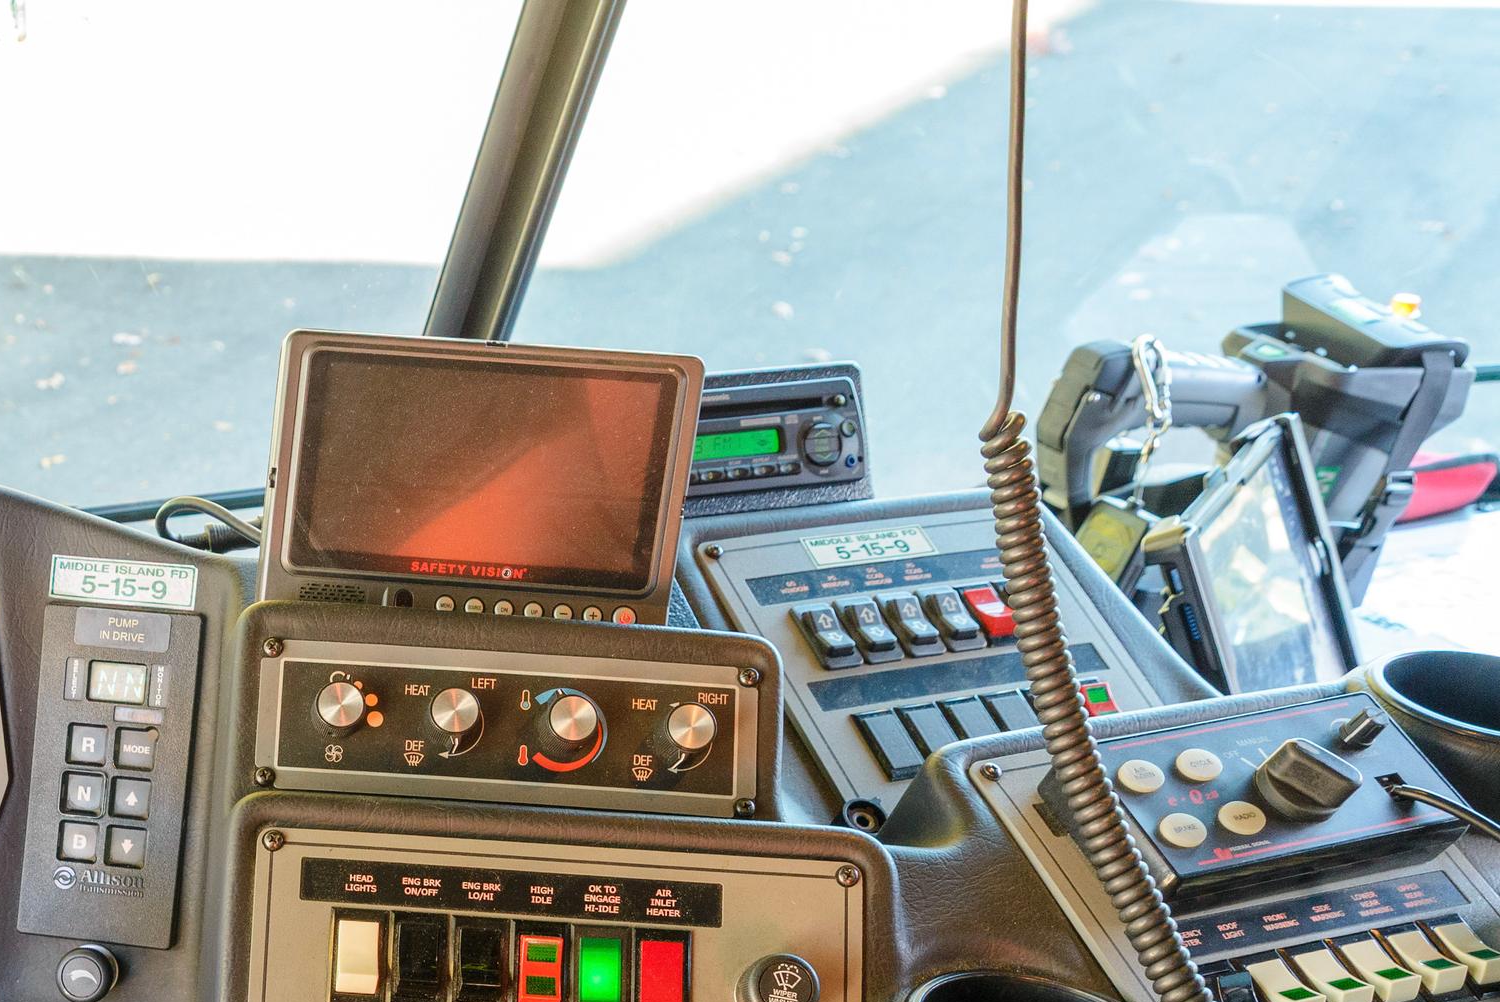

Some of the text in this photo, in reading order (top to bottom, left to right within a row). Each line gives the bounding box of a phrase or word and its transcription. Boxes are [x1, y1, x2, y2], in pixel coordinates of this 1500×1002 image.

[810, 537, 852, 547] MIDDLE
[836, 540, 910, 559] 5-15-9
[59, 561, 188, 579] MIDDLE ISLAND FD
[411, 561, 467, 575] SAFETY
[81, 575, 167, 600] 5-15-9
[108, 617, 139, 628] PUMP
[100, 630, 145, 643] IN DRIVE
[155, 666, 164, 706] MONITOR
[471, 677, 496, 689] LEFT
[405, 684, 430, 696] HEAT
[632, 698, 658, 710] HEAT
[698, 692, 729, 705] RIGHT
[82, 737, 95, 752] R
[123, 744, 150, 754] MODE
[405, 740, 424, 751] DEF
[633, 755, 652, 766] DEF
[77, 786, 91, 801] N
[73, 835, 87, 849] D
[80, 869, 145, 888] Allison
[350, 874, 374, 883] HEAD
[402, 877, 441, 888] ENG BRK
[345, 883, 377, 893] LIGHTS
[462, 881, 501, 891] ENG BRK
[530, 885, 554, 895] HIGH
[588, 884, 617, 894] OK TO
[404, 887, 439, 897] ON/OFF
[468, 891, 494, 901] LO/HI
[655, 889, 672, 897] AIR
[531, 895, 552, 905] IDLE
[584, 895, 621, 904] ENGAGE
[650, 898, 677, 907] INLET
[585, 904, 619, 914] HI-IDLE
[646, 907, 680, 917] HEATER
[1262, 913, 1288, 923] FRONT
[1216, 922, 1238, 932] ROOF
[1262, 919, 1300, 931] WARNING
[1221, 929, 1245, 940] LIGHT
[773, 988, 797, 999] WIPER
